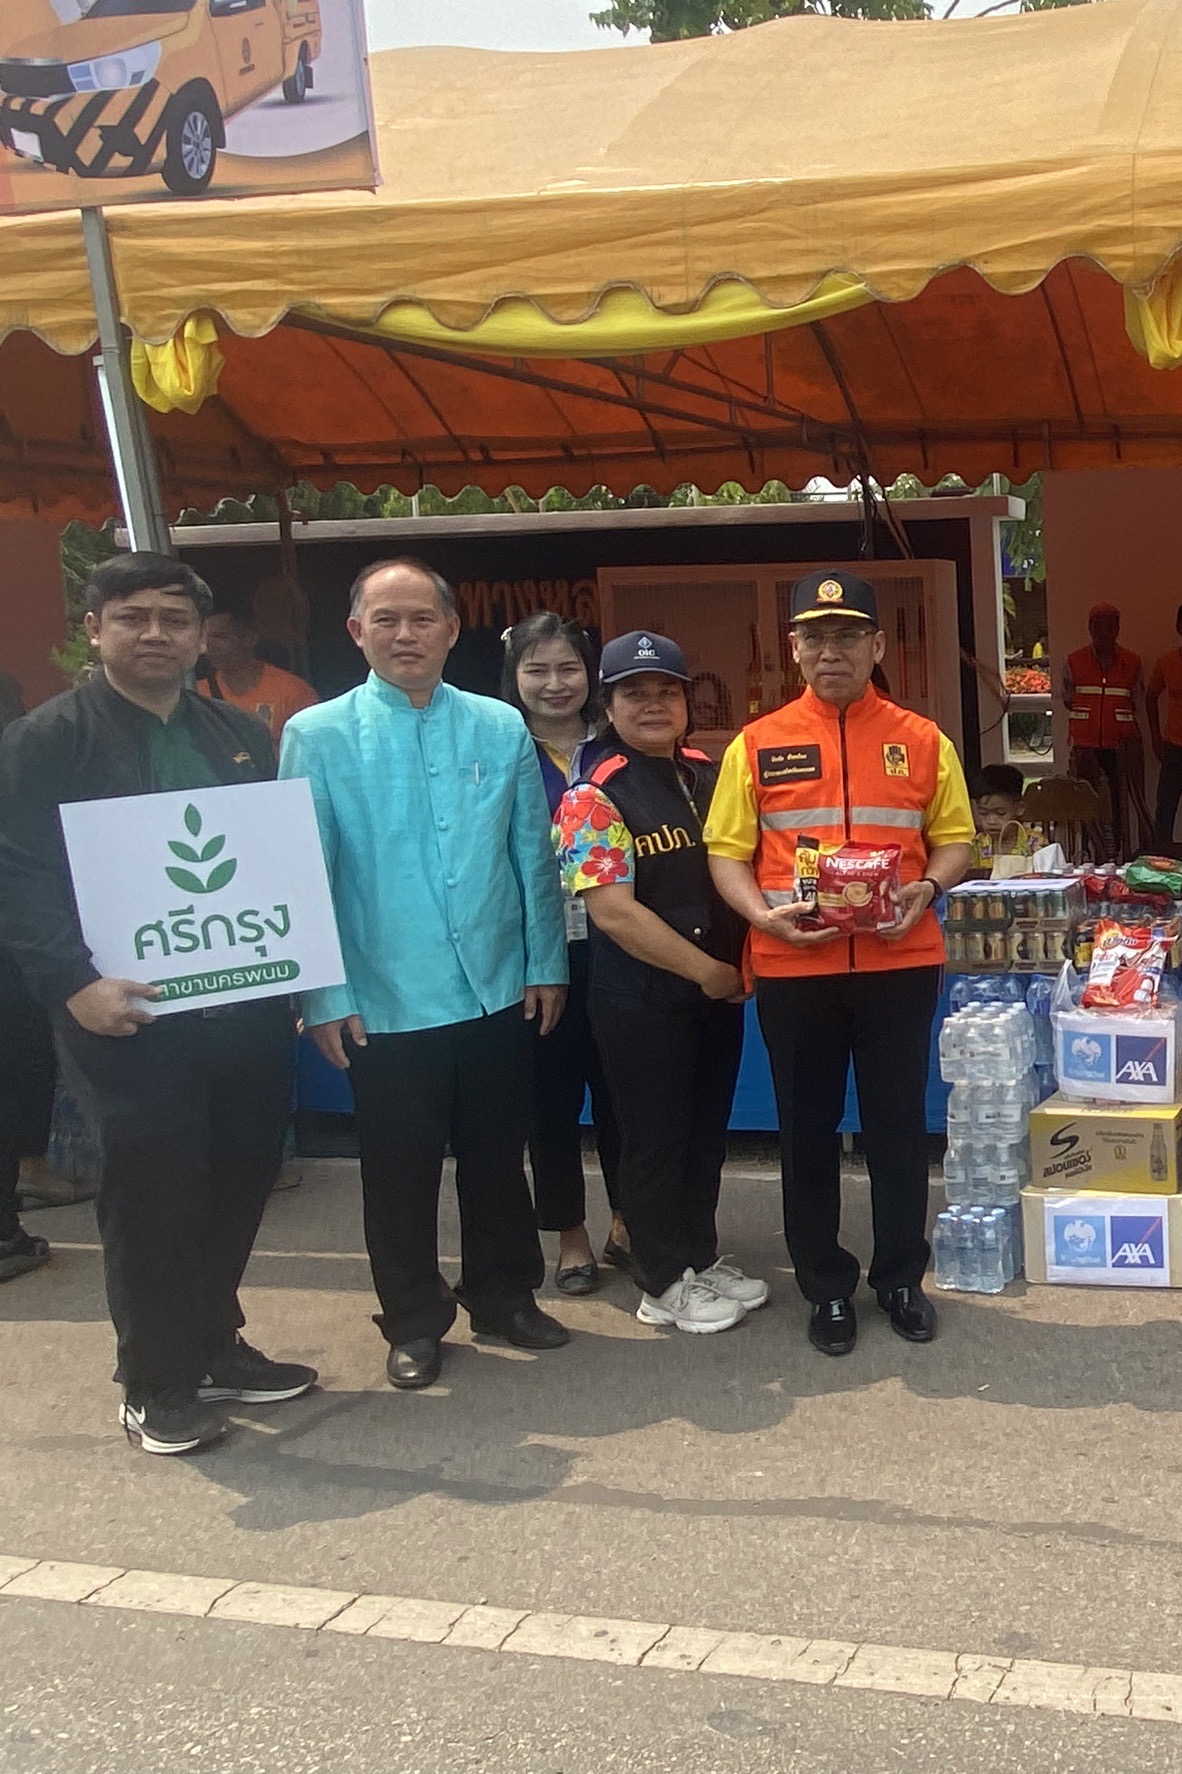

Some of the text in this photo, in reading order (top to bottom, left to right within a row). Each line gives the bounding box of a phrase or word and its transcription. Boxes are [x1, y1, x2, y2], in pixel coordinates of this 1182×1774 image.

[634, 824, 697, 858] คปภ.
[134, 903, 291, 960] ศรีกรุง
[1115, 1060, 1159, 1082] AXA
[1111, 1242, 1155, 1264] AXA
